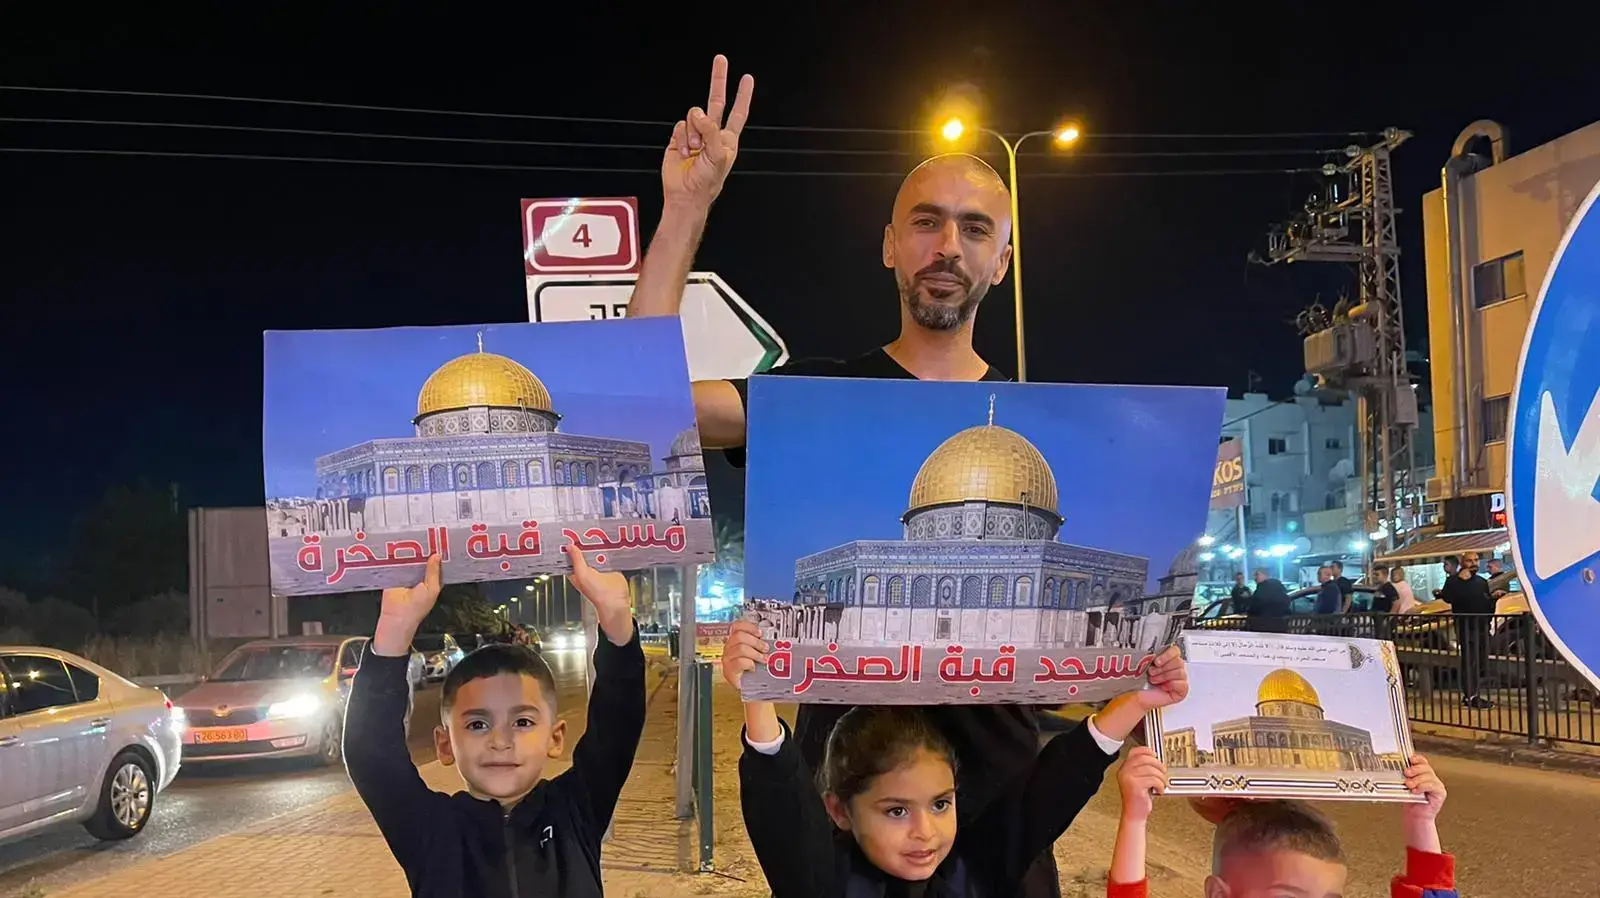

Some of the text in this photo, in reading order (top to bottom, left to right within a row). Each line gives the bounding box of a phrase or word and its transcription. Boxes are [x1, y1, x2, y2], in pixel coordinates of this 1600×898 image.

[572, 223, 592, 248] 4
[296, 520, 688, 585] مسجد قبة الصخرة
[765, 641, 922, 695] الصخرة
[937, 644, 1017, 696] قبة
